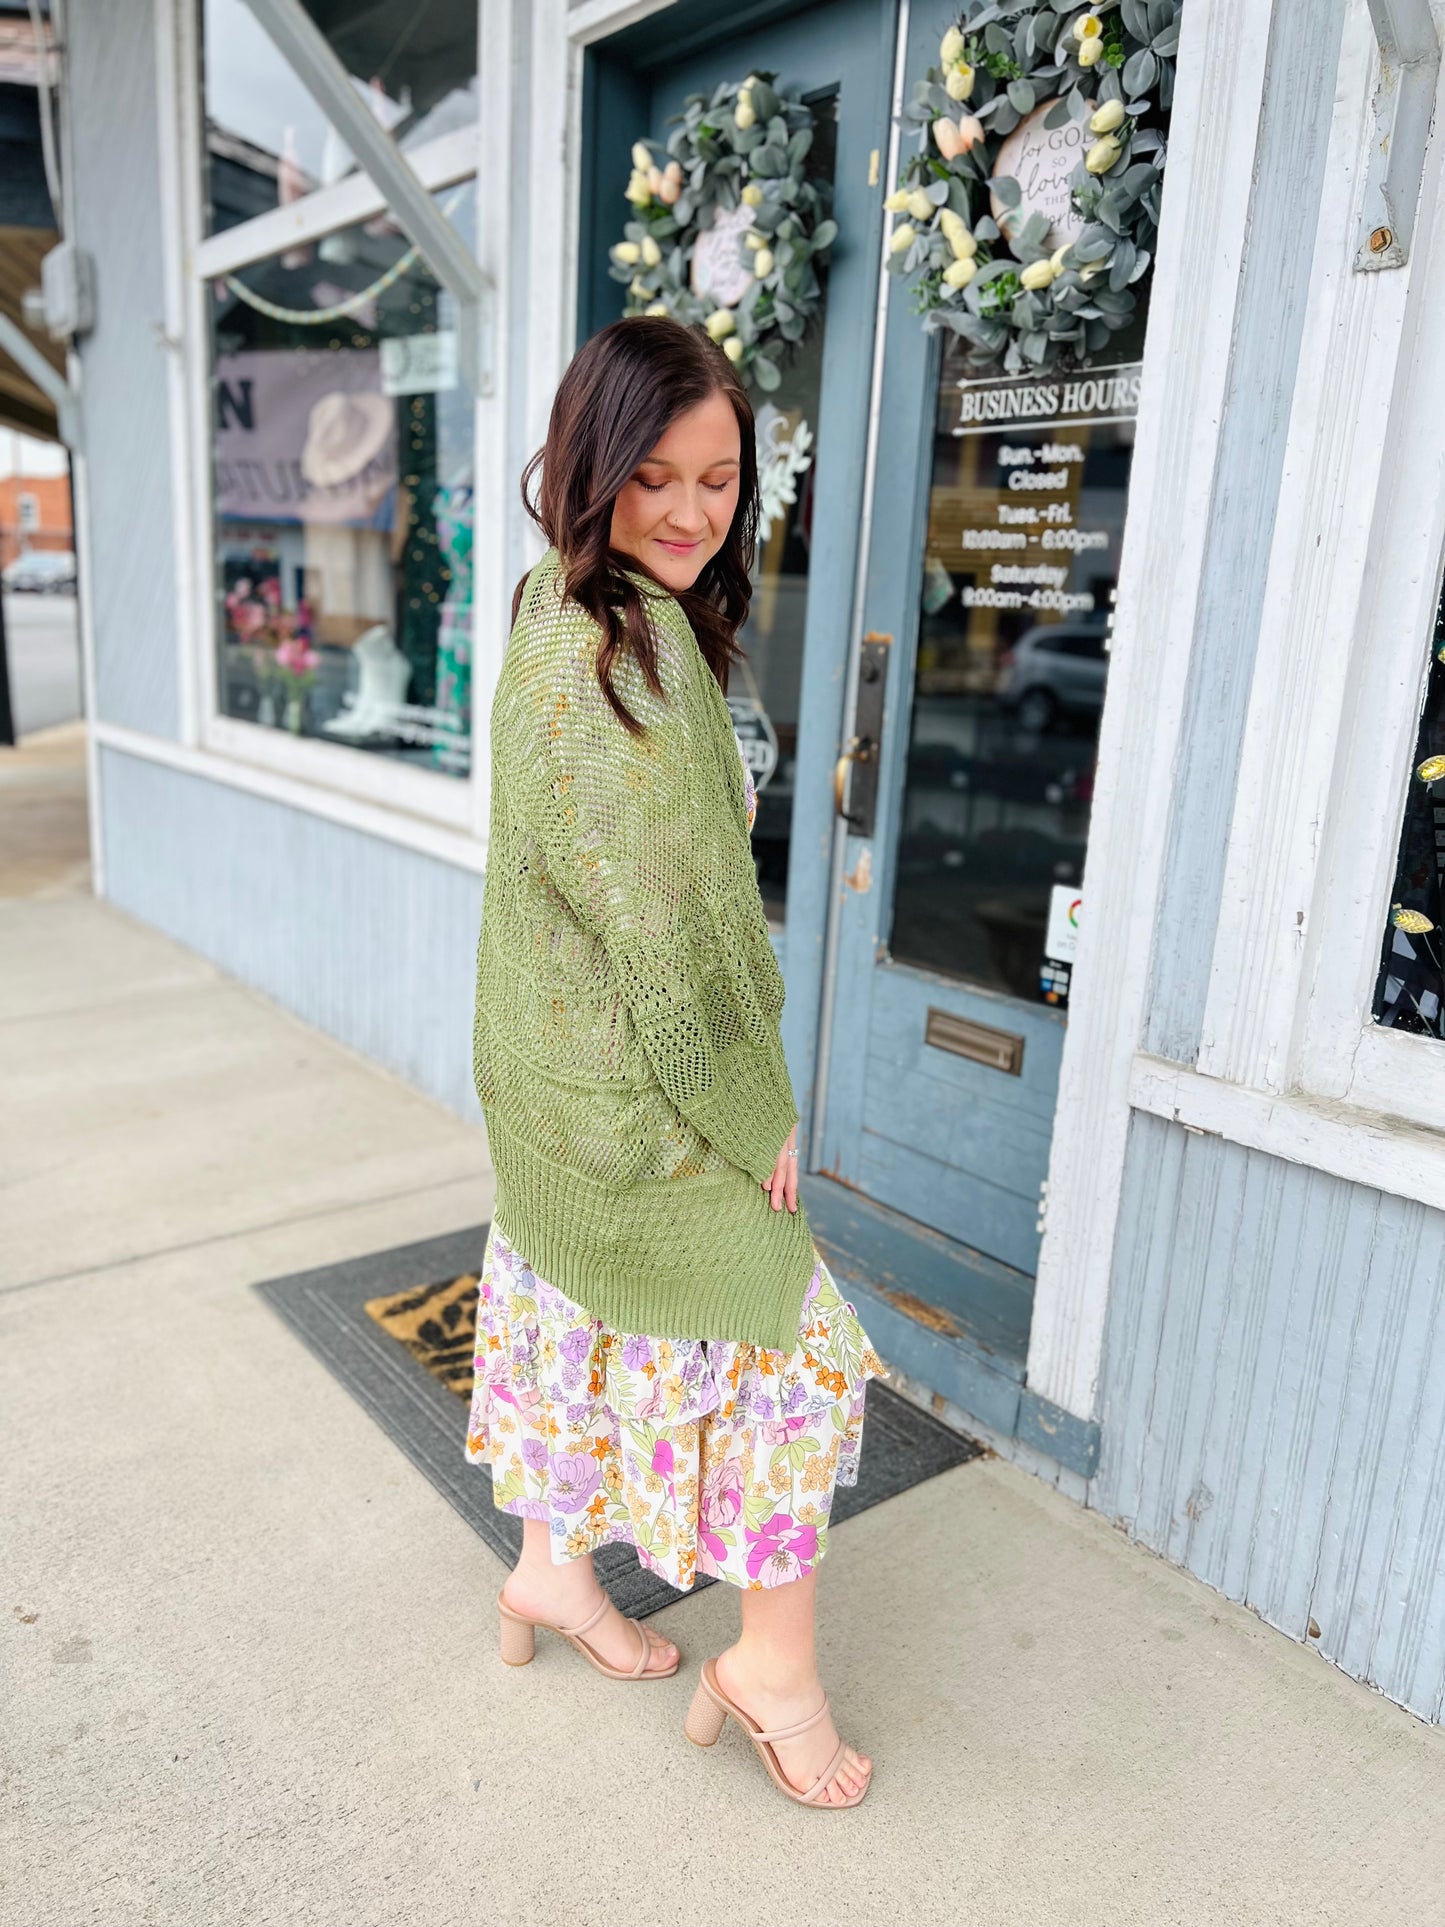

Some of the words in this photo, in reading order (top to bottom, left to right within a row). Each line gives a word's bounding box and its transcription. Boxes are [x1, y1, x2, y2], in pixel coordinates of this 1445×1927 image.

[1014, 131, 1045, 176] for
[960, 384, 1059, 423] BUSINESS
[1060, 376, 1141, 413] HOURS
[1008, 468, 1069, 490] Closed
[991, 564, 1069, 590] Saturday
